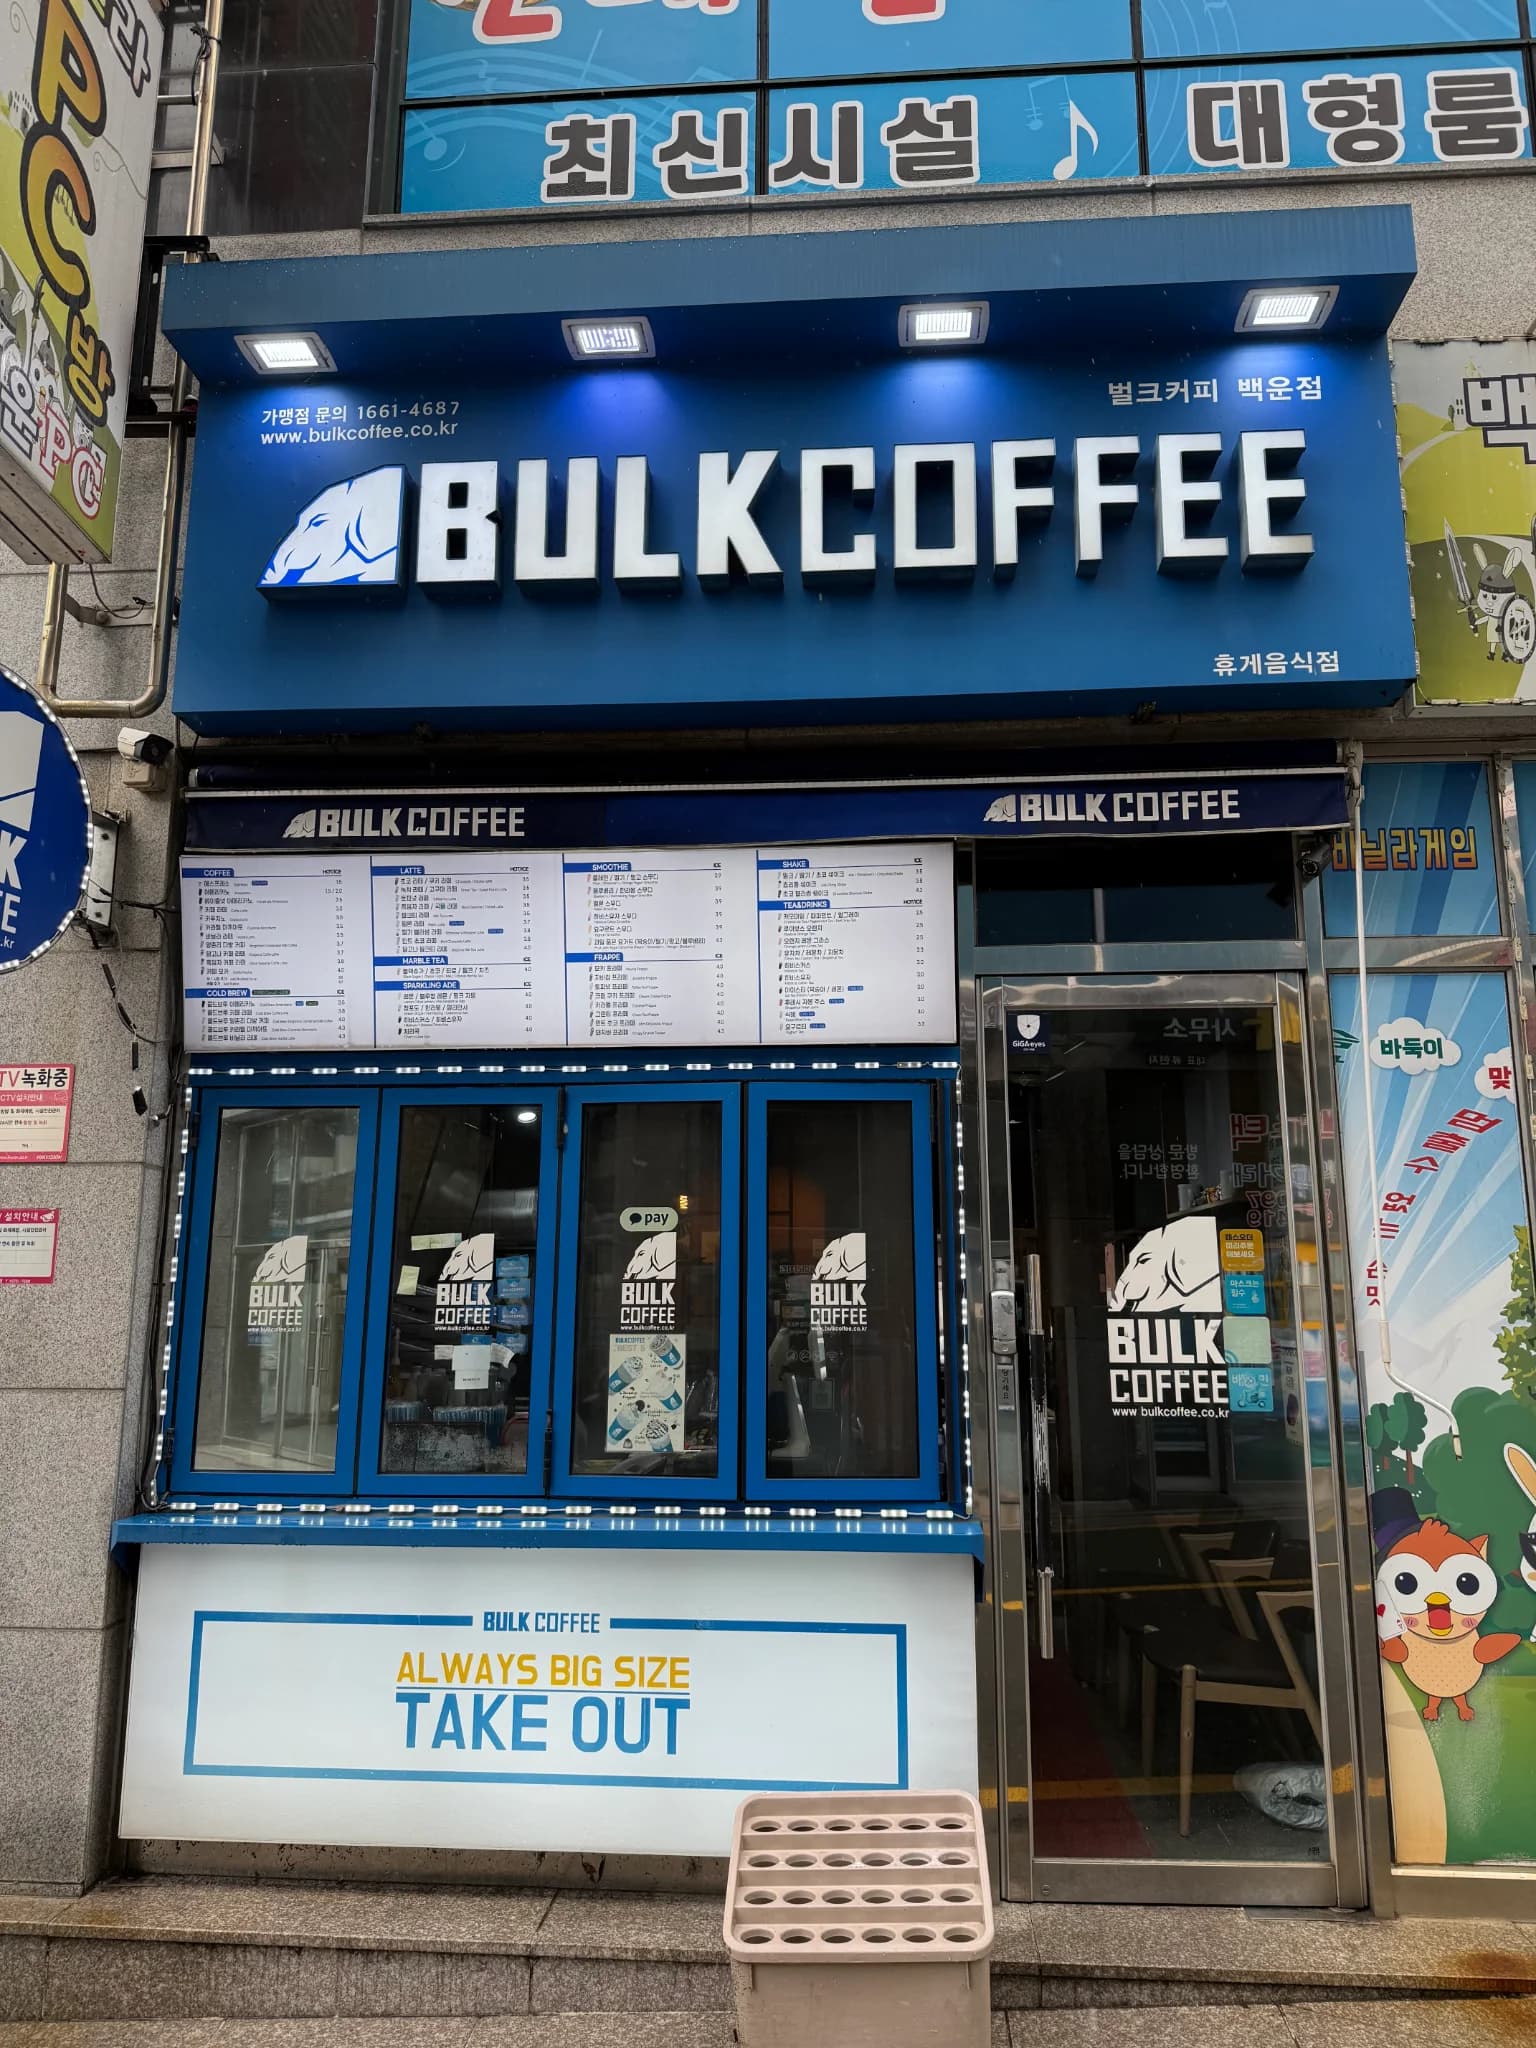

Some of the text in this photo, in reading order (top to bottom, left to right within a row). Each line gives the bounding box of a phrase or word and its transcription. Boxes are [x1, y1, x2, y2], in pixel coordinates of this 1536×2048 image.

[1188, 68, 1527, 168] 대형룸
[543, 97, 978, 201] 최신시설
[1108, 375, 1323, 406] 벌크커피 백운점
[261, 401, 460, 426] 가맹점 문의 1661-4687
[261, 421, 458, 445] www.bulkcoffee.co.kr
[1213, 650, 1340, 677] 휴게음식점
[1020, 789, 1240, 822] BULK COFFEE
[318, 807, 525, 837] BULK COFFEE
[203, 869, 232, 877] COFFEE
[400, 867, 422, 875] LATTE
[783, 901, 828, 909] TEA&DRINKS
[402, 957, 446, 965] MARBLE TEA
[206, 989, 227, 998] COLD
[227, 989, 248, 998] BREW
[402, 981, 457, 989] SPARKLING ADE
[22, 1069, 68, 1088] 녹화중
[644, 1212, 669, 1226] pay
[249, 1285, 304, 1307] BULK
[436, 1283, 491, 1305] BULK
[621, 1282, 675, 1305] BULK
[810, 1283, 866, 1306] BULK
[248, 1309, 302, 1326] COFFEE
[434, 1307, 491, 1325] COFFEE
[620, 1307, 675, 1324] COFFEE
[810, 1308, 867, 1325] COFFEE
[1107, 1319, 1226, 1364] BULK
[1109, 1369, 1229, 1403] COFFEE
[483, 1611, 601, 1634] BULK COFFEE
[397, 1652, 691, 1689] ALWAYS BIG SIZE
[396, 1692, 691, 1755] TAKE OUT
